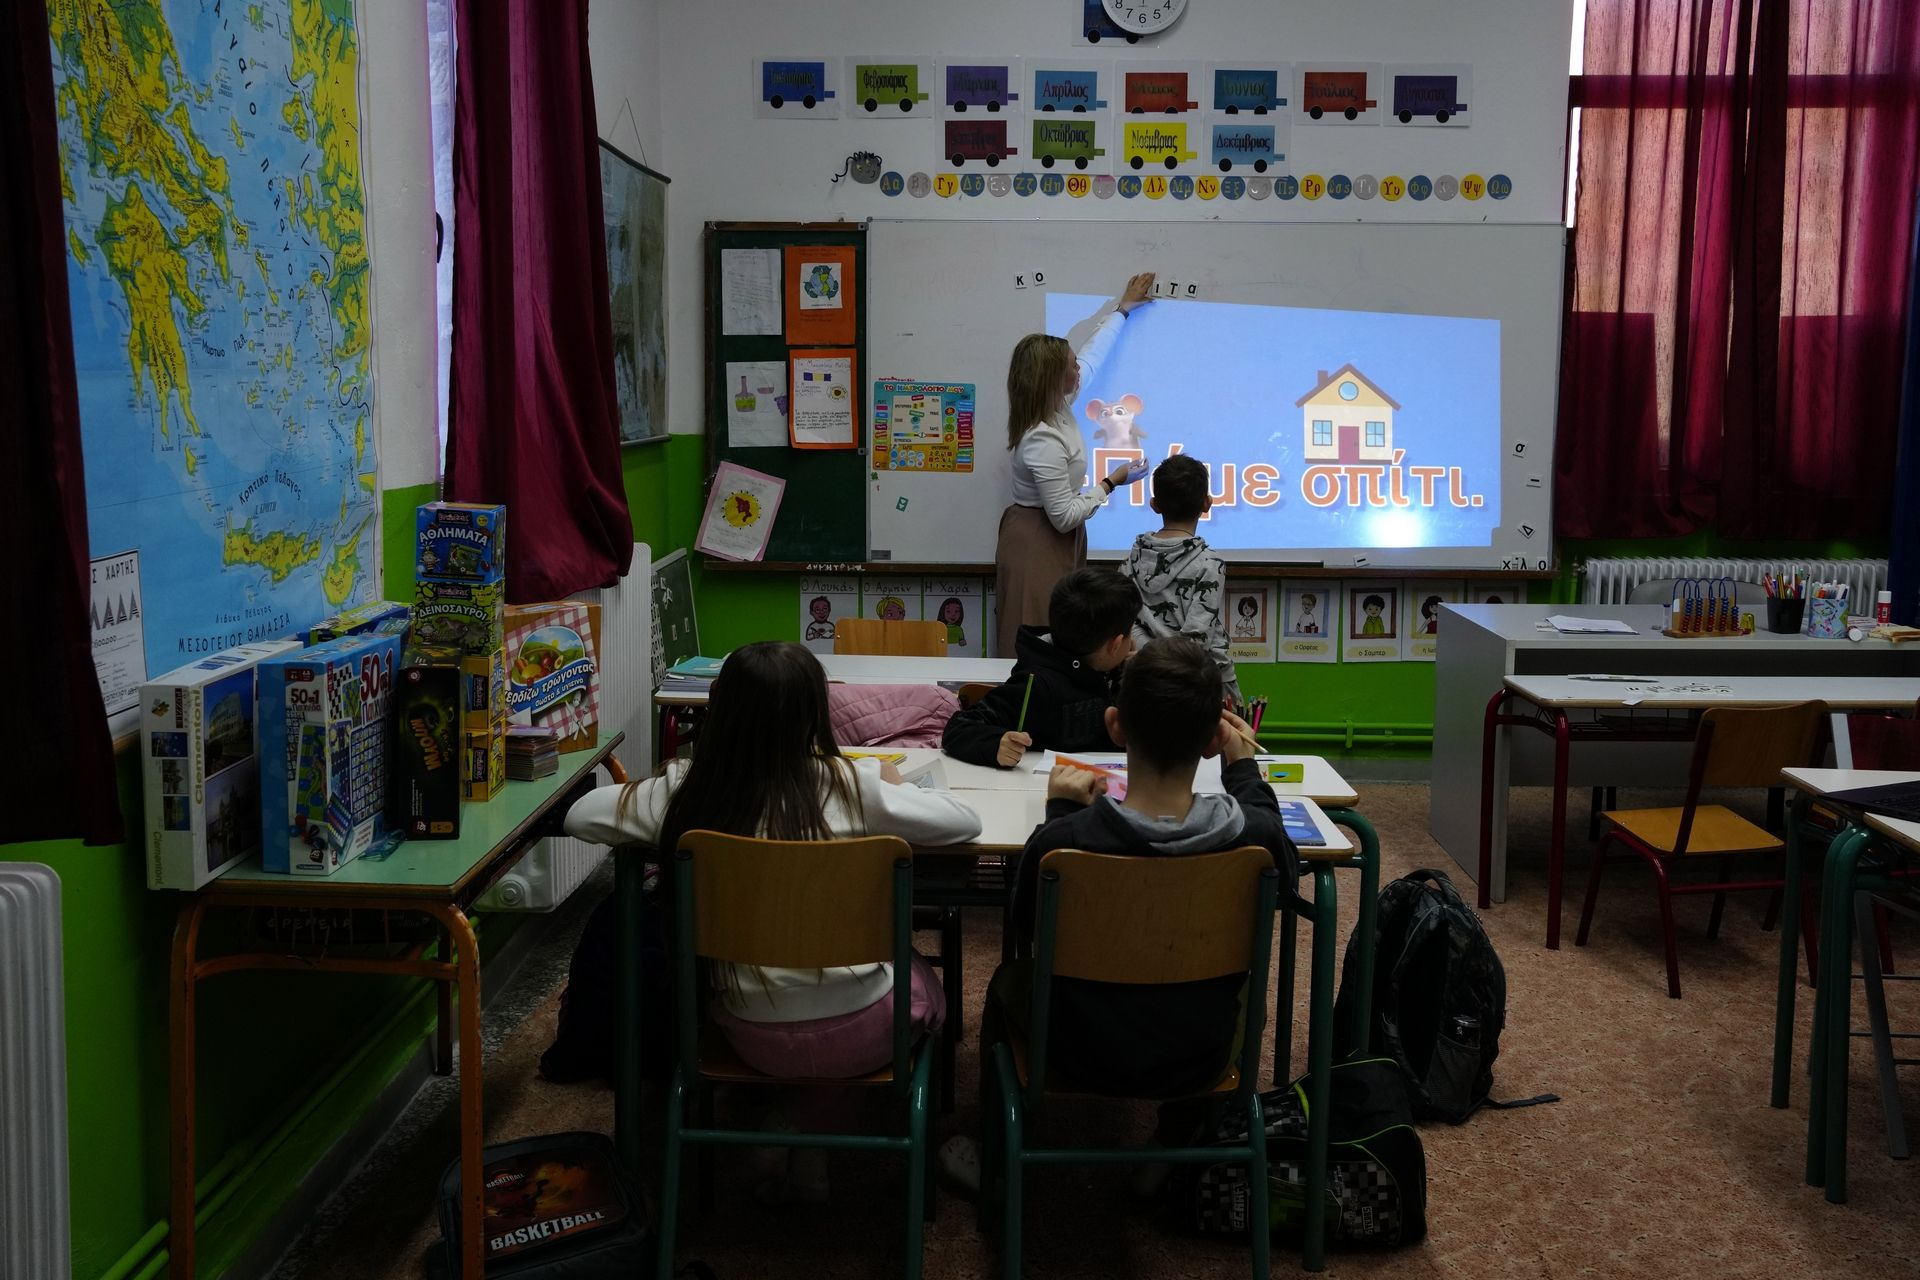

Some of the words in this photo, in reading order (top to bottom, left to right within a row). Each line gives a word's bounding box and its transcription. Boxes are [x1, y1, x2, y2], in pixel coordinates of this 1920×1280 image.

[1115, 0, 1123, 9] 8
[1126, 8, 1133, 18] 7
[1153, 9, 1161, 19] 5
[1163, 0, 1171, 10] 4
[1139, 13, 1147, 24] 6
[863, 69, 909, 94] Φεβρουάριος
[1043, 80, 1089, 103] Απρίλιος
[1040, 122, 1089, 148] Οκτώβριος
[1131, 129, 1178, 153] Νοέμβριος
[1216, 131, 1271, 152] Δεκέμβριος
[937, 177, 955, 194] Γγ
[1015, 177, 1035, 194] Ζζ
[1067, 177, 1088, 192] Θθ
[1146, 177, 1166, 194] Λλ
[1171, 178, 1192, 197] Μμ
[1197, 178, 1217, 194] Νν
[1304, 178, 1321, 198] Ρρ
[1463, 178, 1481, 195] Ψψ
[1491, 178, 1510, 194] Ωω
[884, 384, 894, 392] ΤΟ
[274, 469, 301, 501] Πέλαγος
[1299, 448, 1485, 508] σπίτι.
[419, 527, 489, 546] ΑΘΛΗΜΑΤΑ
[105, 559, 134, 581] ΧΑΡΤΗΣ
[812, 579, 854, 592] Λουκάς
[925, 582, 932, 592] Η
[940, 583, 970, 596] Χαρά
[419, 604, 487, 621] ΔΕΙΝΟΣΑΥΡΟΙ
[178, 632, 242, 653] ΜΕΣΟΓΕΙΟΣ
[247, 613, 291, 642] ΘΑΛΑΣΣΑ
[1239, 649, 1258, 658] Μαρίνα
[360, 652, 380, 702] 50
[385, 648, 393, 690] 1
[542, 663, 595, 694] τρώγοντας
[291, 689, 307, 703] 50
[314, 690, 319, 703] 1
[535, 693, 554, 707] σωστά
[193, 688, 204, 805] Clementoni
[486, 1172, 525, 1189] BASKETBALL
[490, 1210, 605, 1252] BASKETBALL
